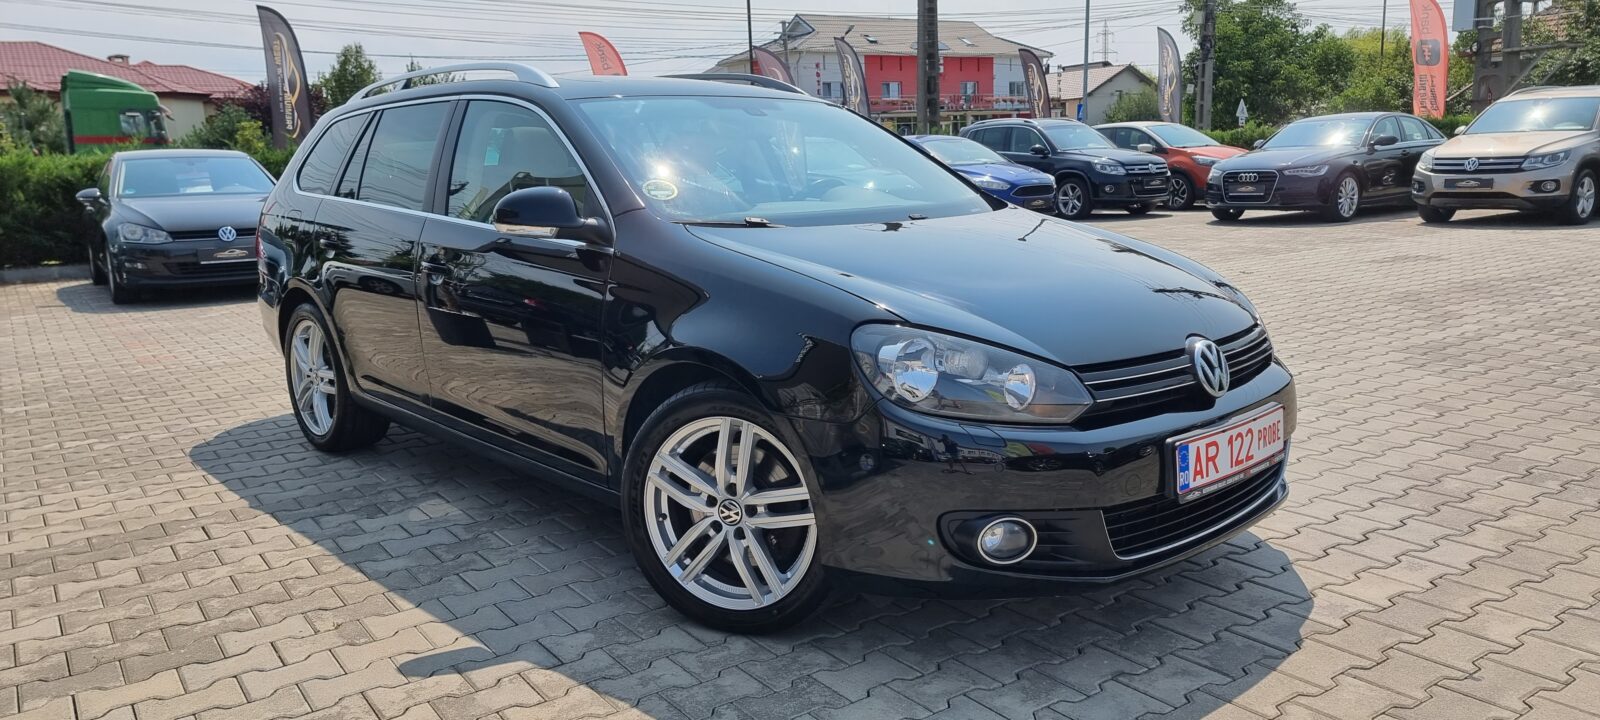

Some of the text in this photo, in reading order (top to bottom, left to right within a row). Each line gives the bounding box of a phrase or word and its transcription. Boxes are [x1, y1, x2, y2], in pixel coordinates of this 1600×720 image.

[1193, 420, 1281, 482] AR 122 PROBE
[1180, 470, 1189, 487] RO
